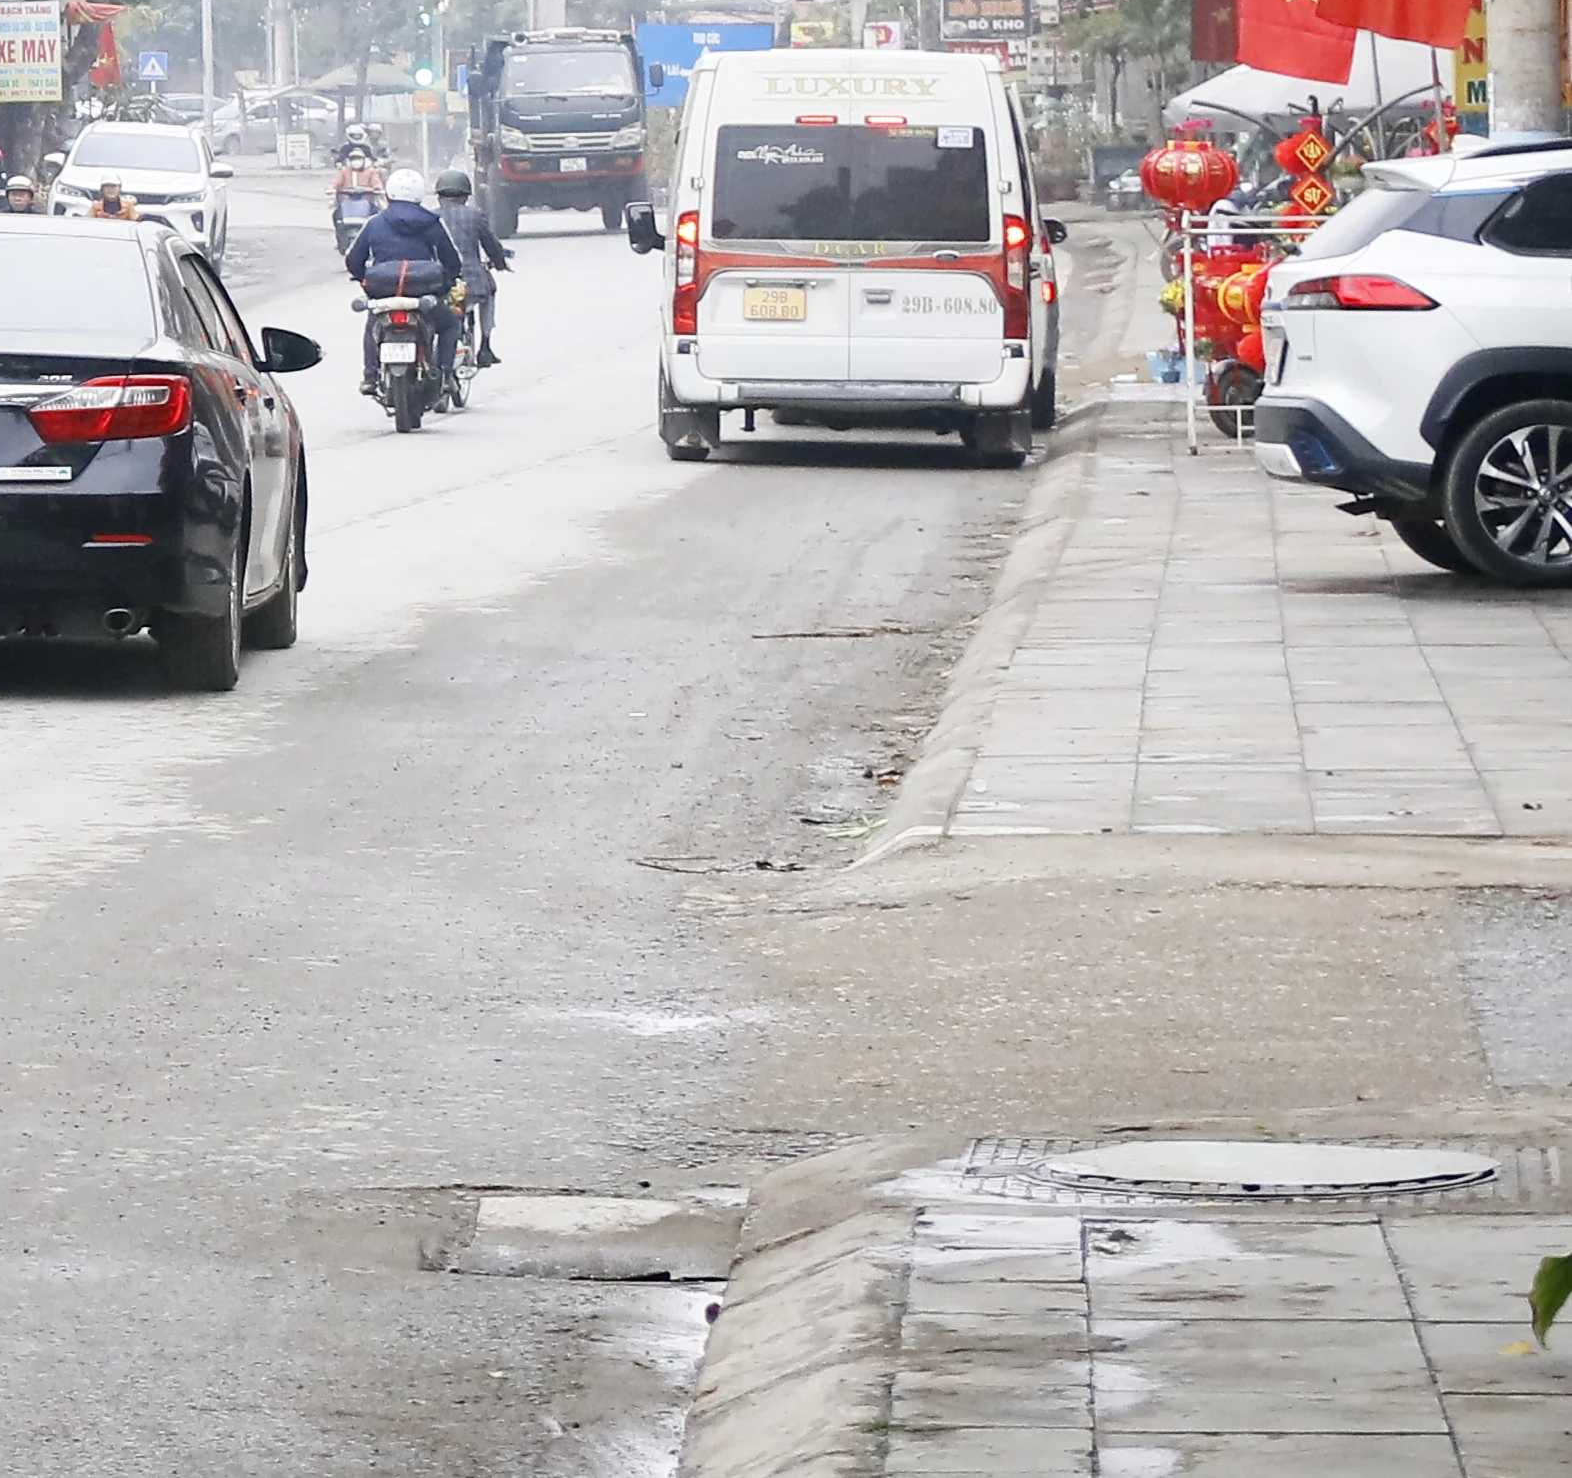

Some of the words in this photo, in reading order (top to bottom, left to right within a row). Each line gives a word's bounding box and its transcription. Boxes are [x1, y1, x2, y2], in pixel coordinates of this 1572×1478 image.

[992, 19, 1025, 30] KHO
[21, 34, 57, 63] MÁY
[763, 76, 939, 97] LUXURY
[761, 290, 788, 303] 29B
[901, 296, 998, 316] 29B-608.80
